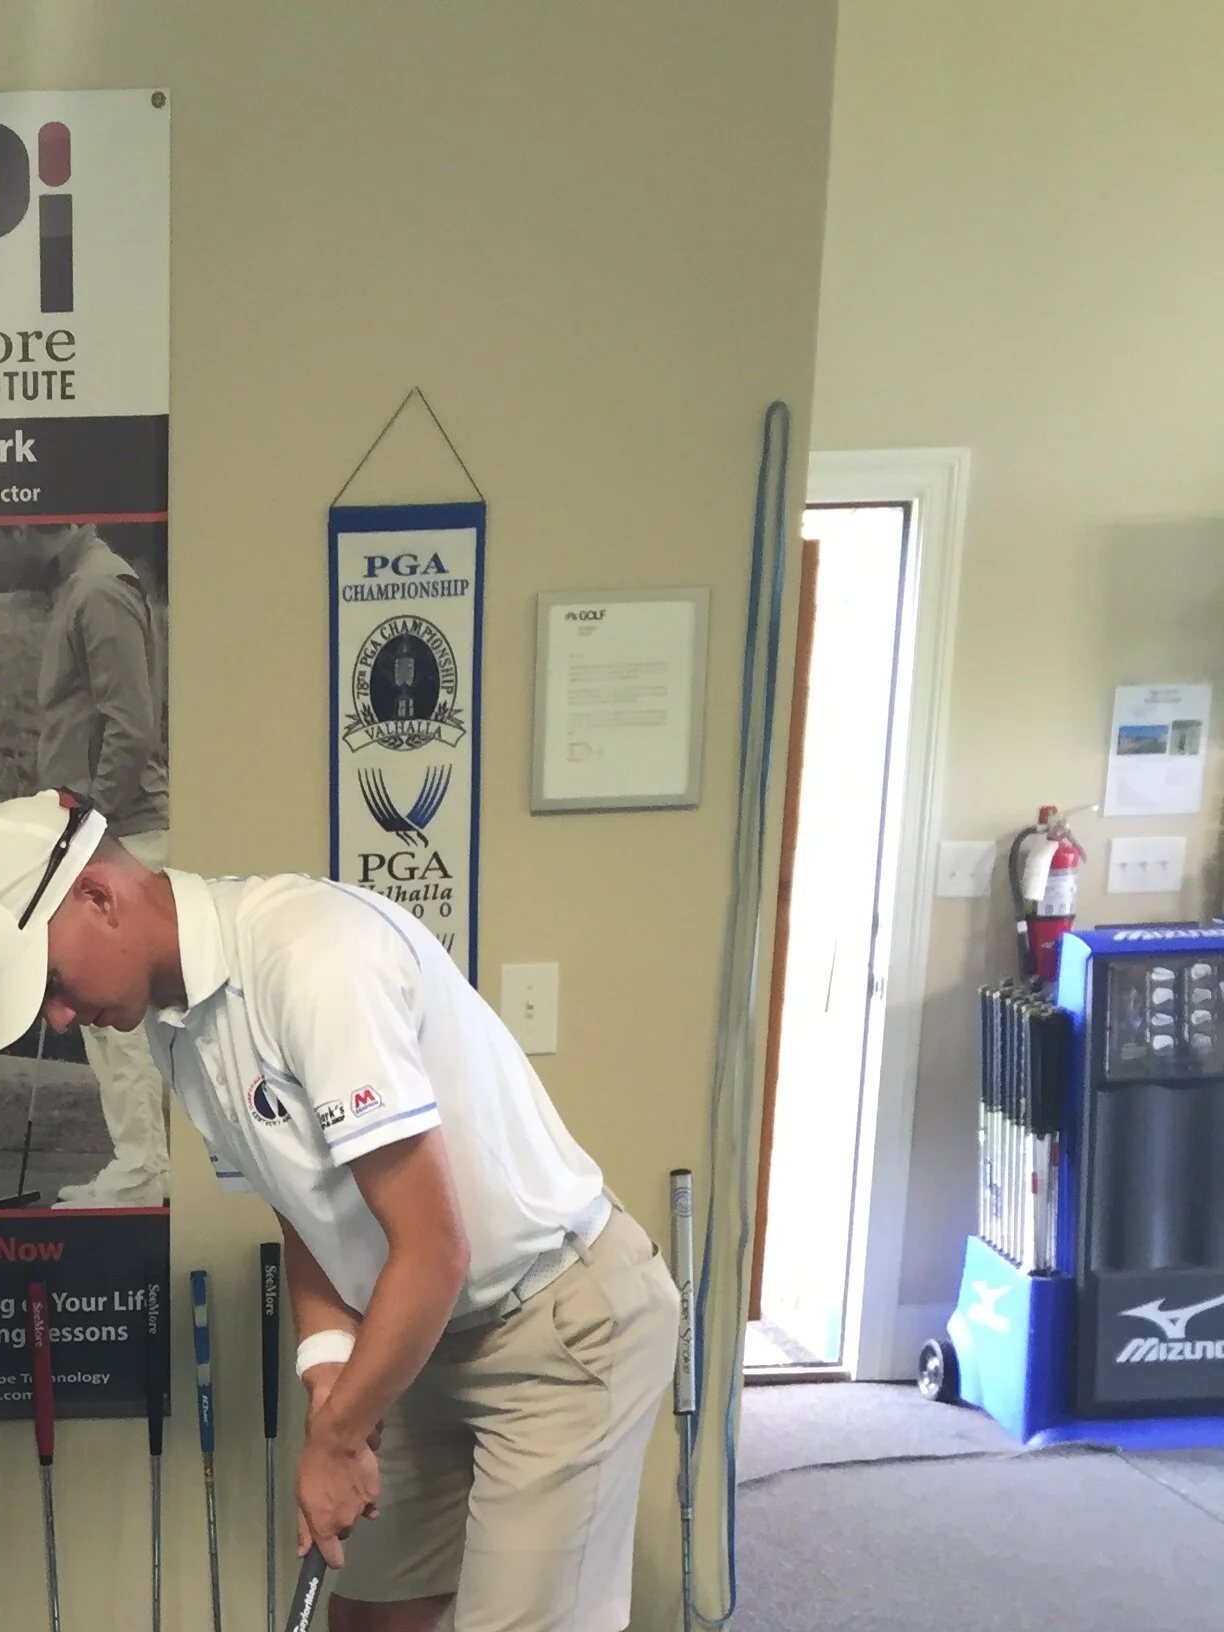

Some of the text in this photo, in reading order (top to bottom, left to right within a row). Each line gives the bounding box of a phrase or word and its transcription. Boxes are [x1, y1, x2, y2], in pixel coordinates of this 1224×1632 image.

[363, 552, 449, 578] PGA
[342, 579, 469, 602] CHAMPIONSHIP
[360, 640, 382, 667] PGA
[379, 619, 455, 695] CHAMPIONSHIP
[365, 720, 443, 741] VALHALLA
[358, 851, 453, 883] PGA
[52, 1291, 107, 1312] Your
[114, 1289, 147, 1311] Lif
[265, 1265, 277, 1316] SeeMore
[148, 1283, 160, 1335] SeeMore
[32, 1301, 44, 1347] SeeMore
[49, 1324, 129, 1343] essons
